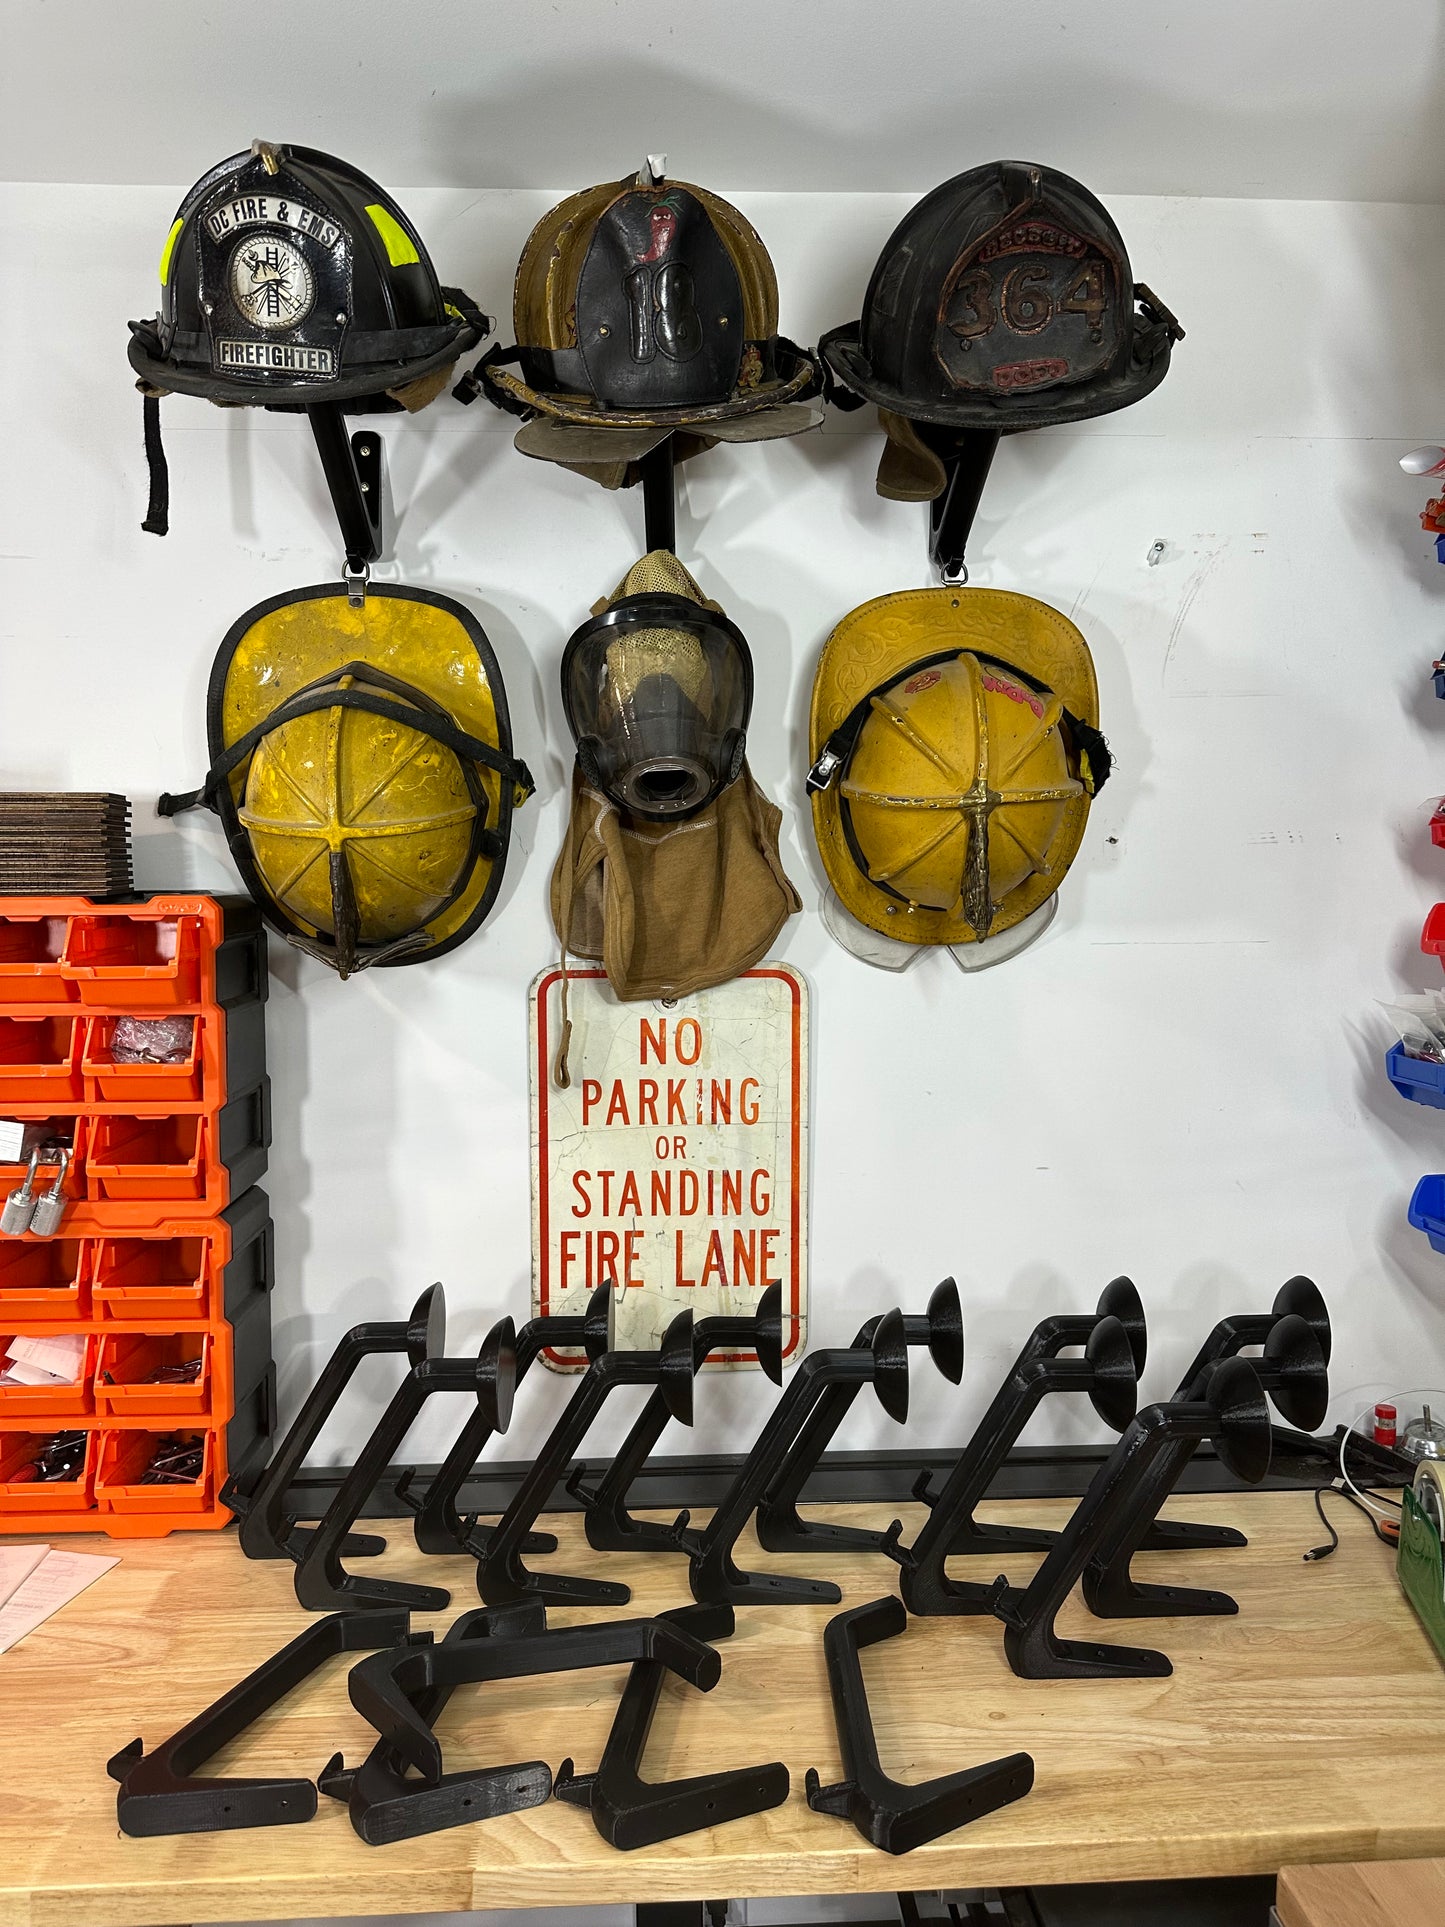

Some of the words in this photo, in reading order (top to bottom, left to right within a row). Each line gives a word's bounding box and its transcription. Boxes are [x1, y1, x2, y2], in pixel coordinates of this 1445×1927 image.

[209, 209, 230, 236] DC
[231, 198, 268, 222] FIRE
[277, 201, 289, 222] &
[297, 209, 335, 245] EMS
[622, 261, 703, 364] 18
[948, 260, 1108, 340] 364
[221, 343, 329, 371] FIREFIGHTER
[640, 1018, 702, 1065] NO
[582, 1078, 760, 1126] PARKING
[656, 1136, 687, 1159] OR
[571, 1168, 770, 1218] STANDING
[560, 1230, 645, 1288] FIRE
[675, 1229, 780, 1287] LANE
